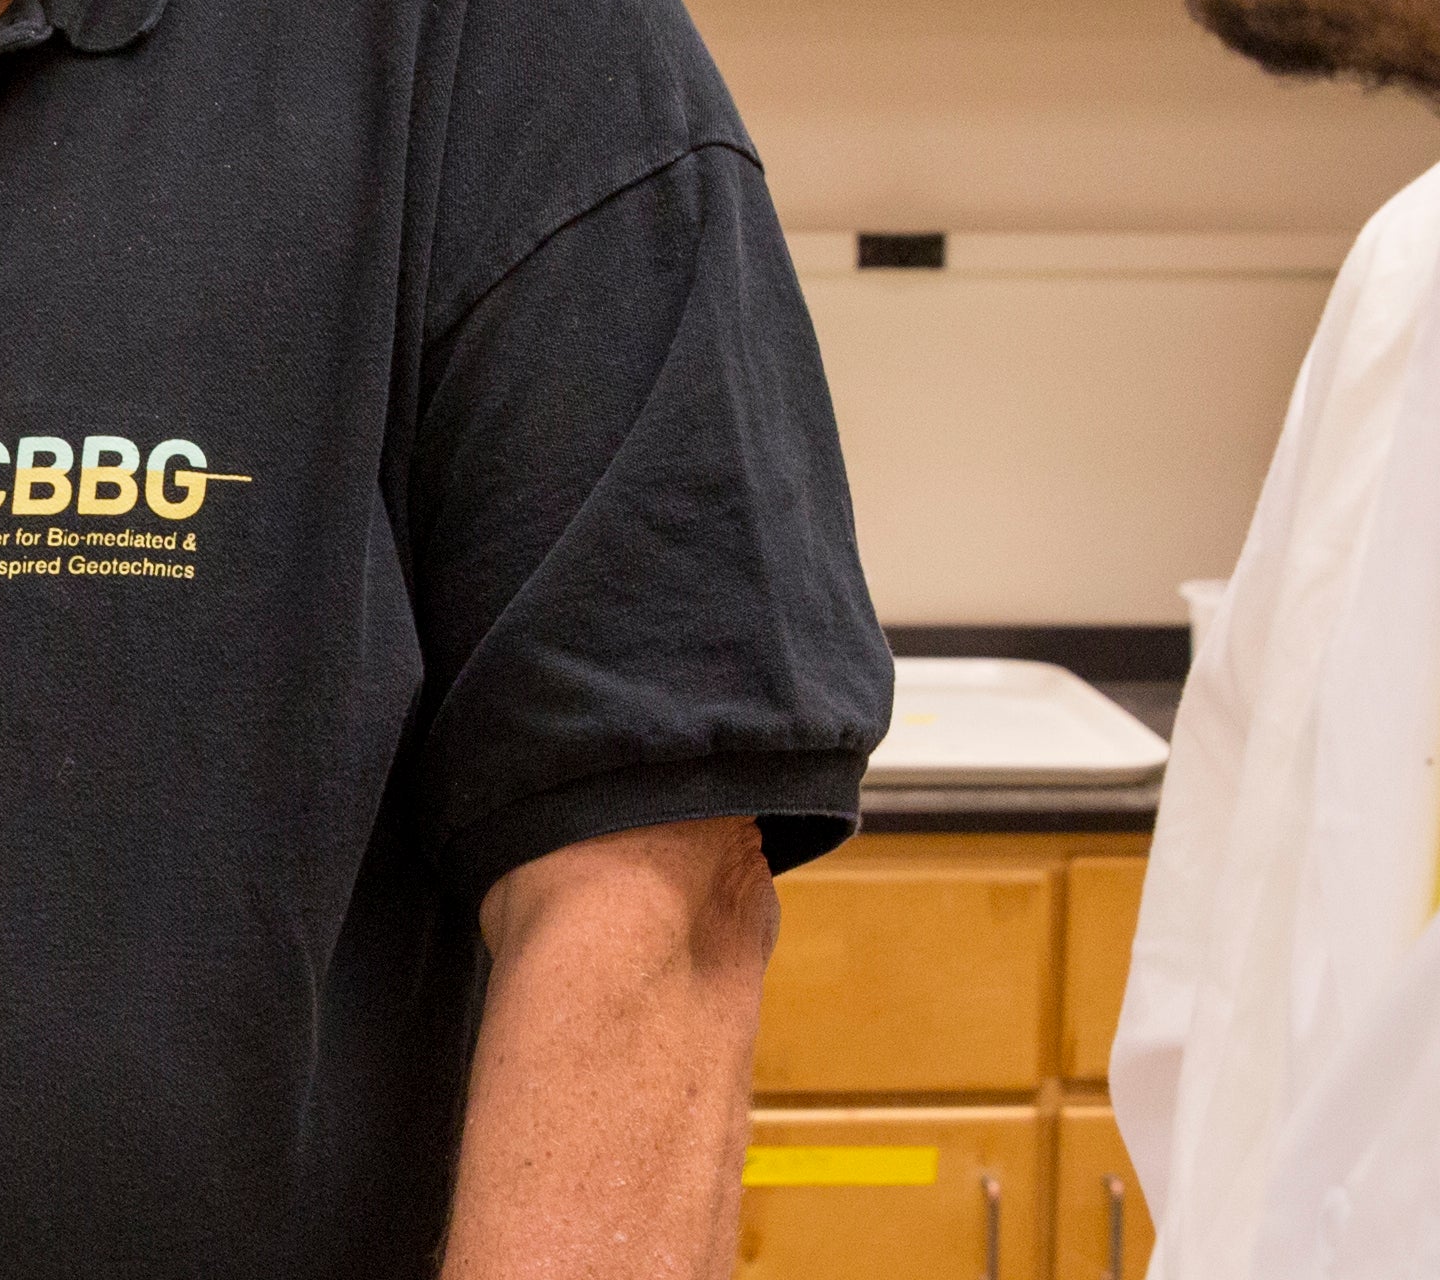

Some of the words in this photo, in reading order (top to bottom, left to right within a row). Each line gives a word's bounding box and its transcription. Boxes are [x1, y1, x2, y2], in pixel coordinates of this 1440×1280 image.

[15, 528, 41, 547] for
[47, 527, 177, 551] Bio-mediated
[182, 533, 198, 552] &
[68, 555, 196, 580] Geotechnics
